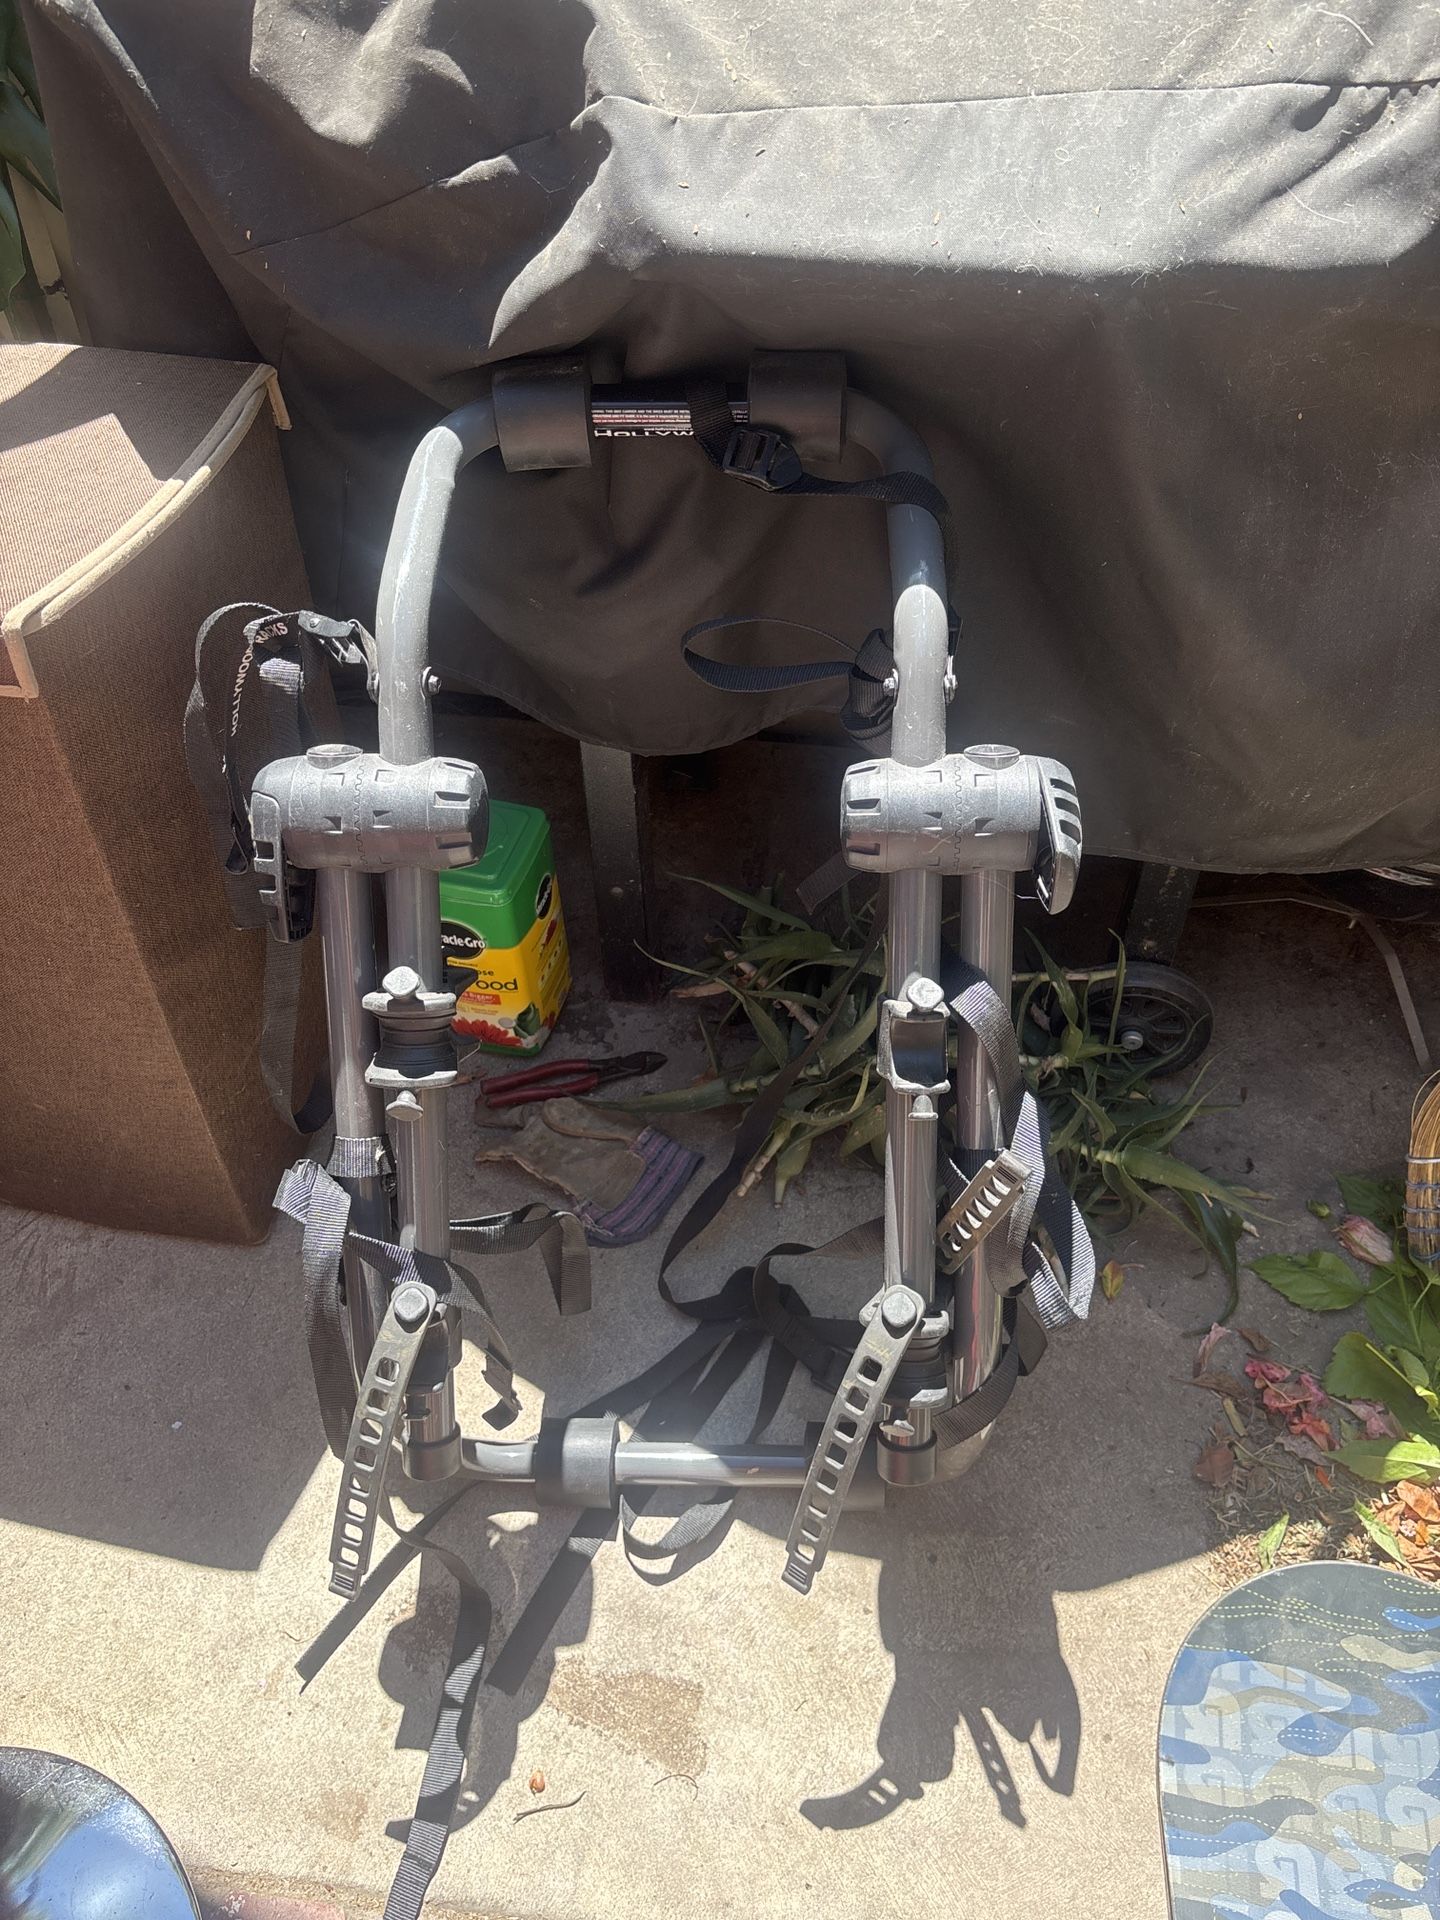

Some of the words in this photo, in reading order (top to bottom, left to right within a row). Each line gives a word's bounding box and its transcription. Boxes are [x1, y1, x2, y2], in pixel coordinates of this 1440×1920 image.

[594, 429, 694, 437] HOLLYW
[255, 622, 288, 644] RACKS
[475, 976, 518, 991] ood
